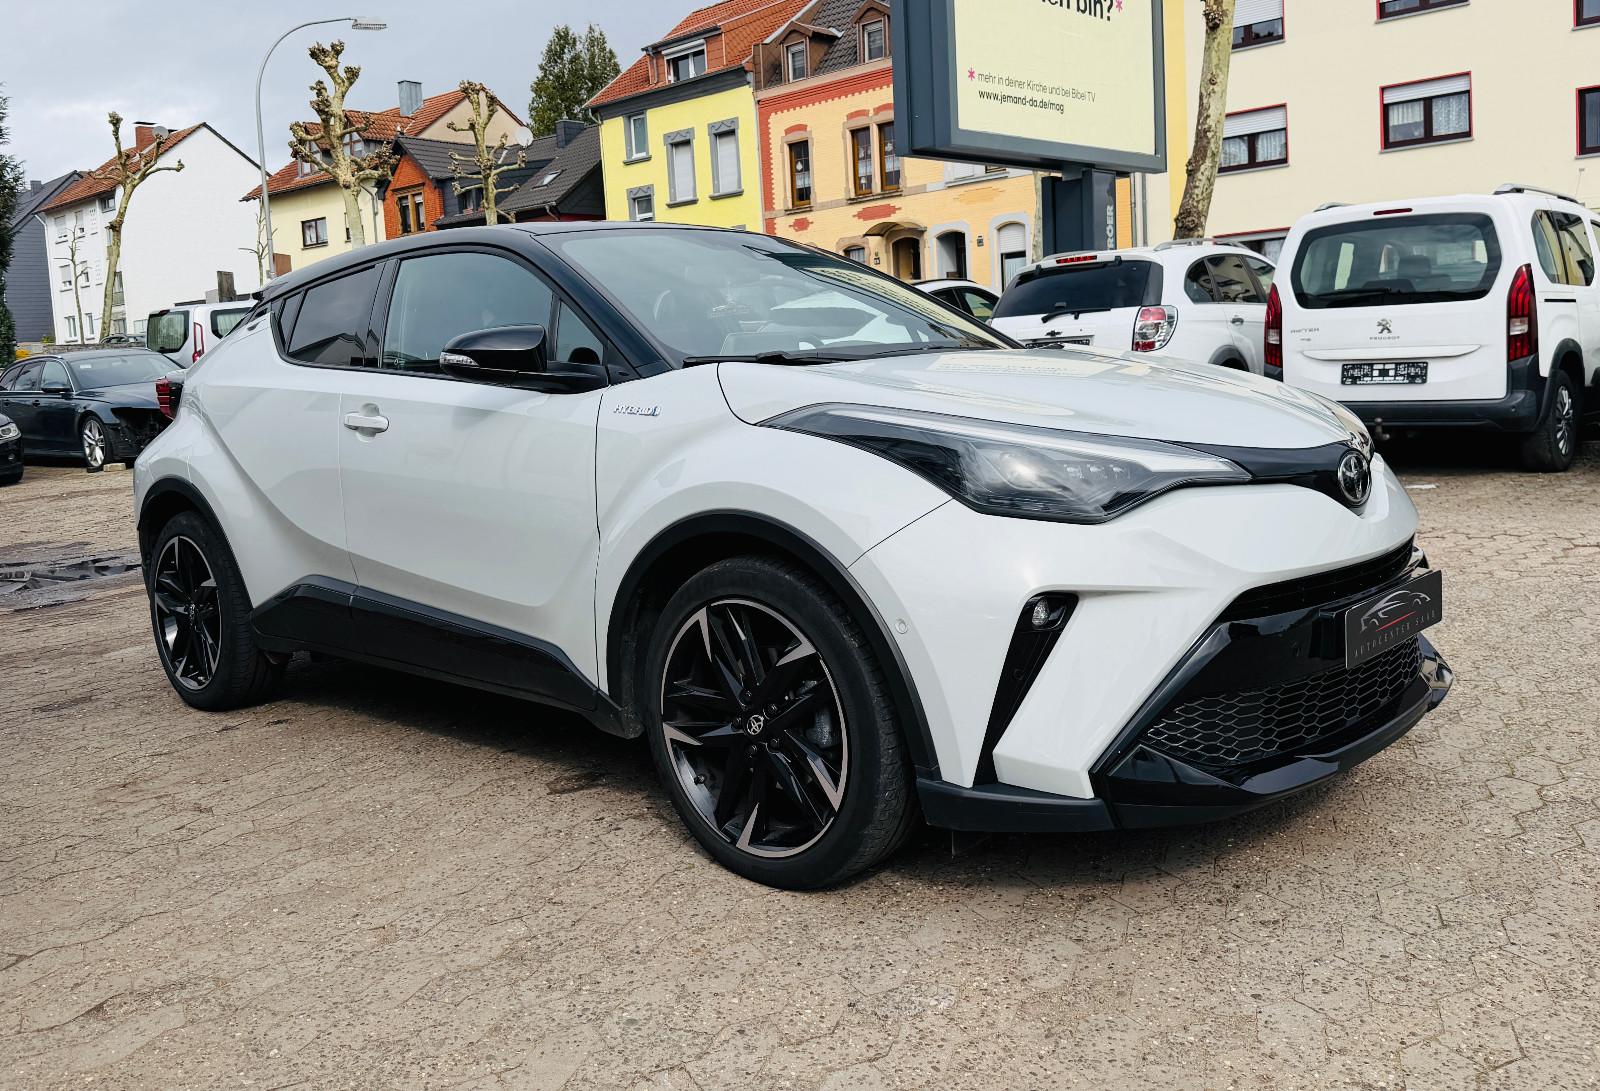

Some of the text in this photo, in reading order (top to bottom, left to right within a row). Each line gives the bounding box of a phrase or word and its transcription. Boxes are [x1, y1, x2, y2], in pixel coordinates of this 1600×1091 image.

[977, 72, 1096, 103] mehr in deiner Kirche und bei Bibel TV
[978, 89, 1065, 115] www.jemand-da.de/mog
[613, 403, 652, 416] HYBRID
[1354, 622, 1410, 658] AUTOCENTER
